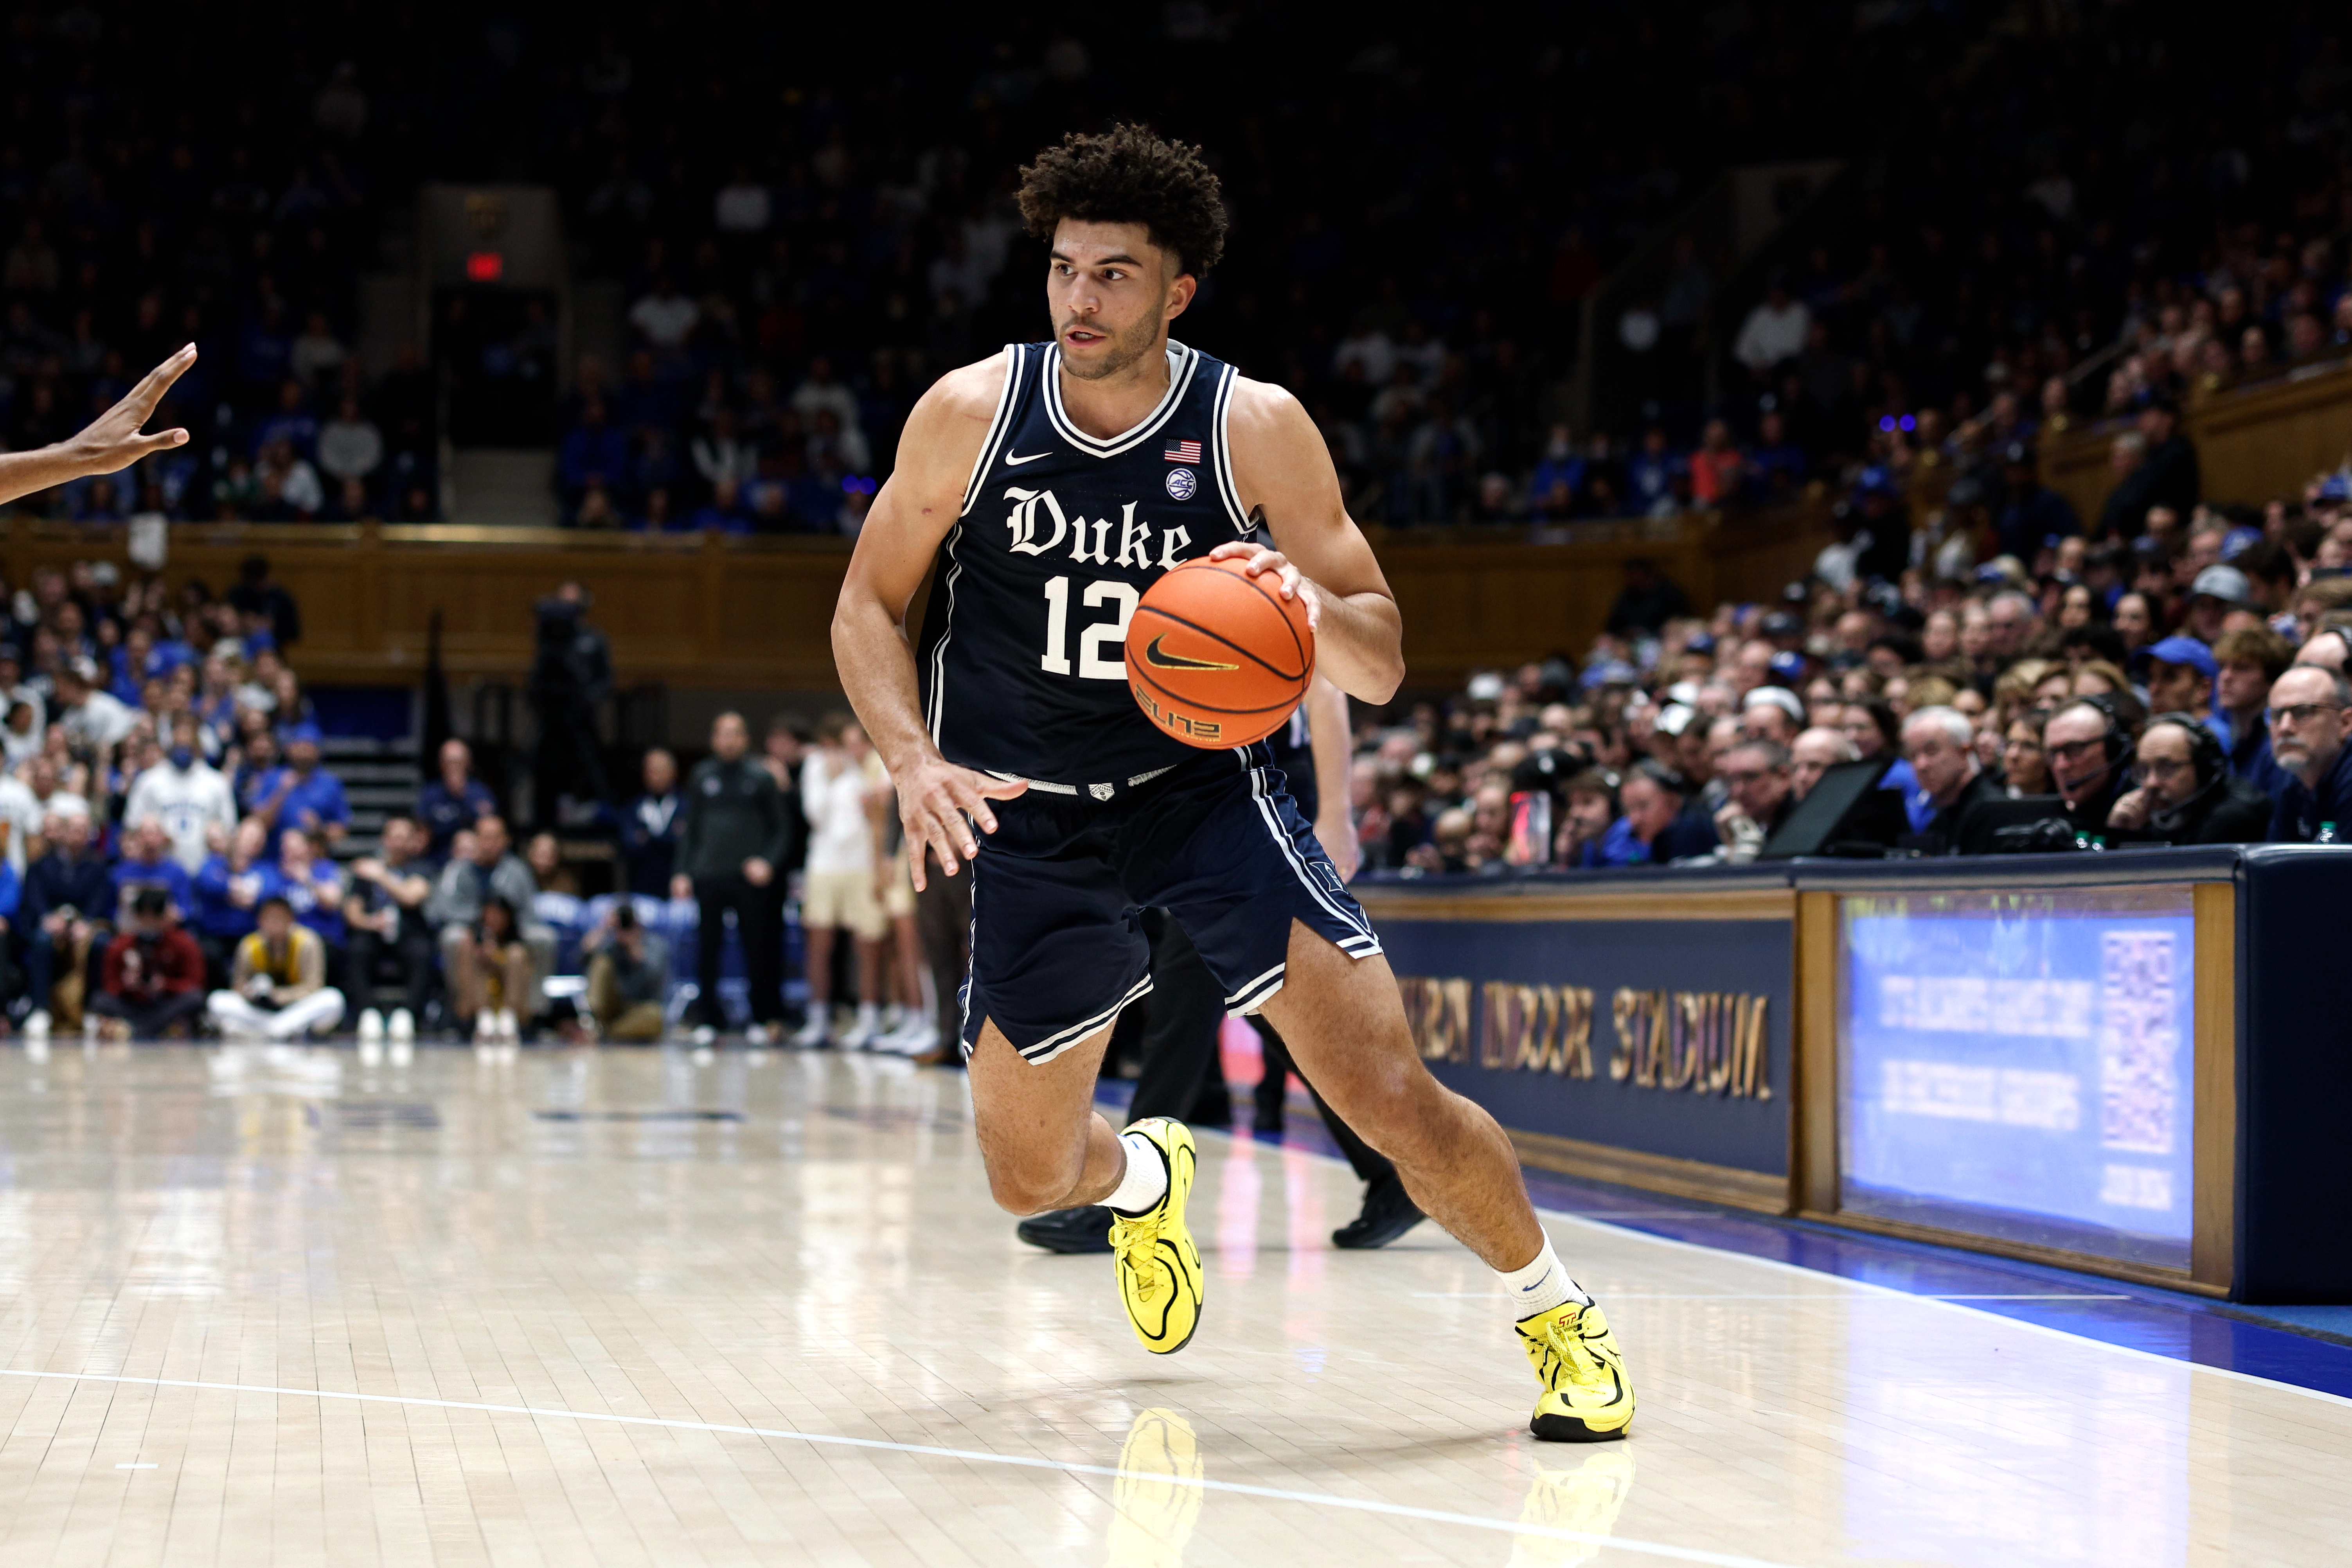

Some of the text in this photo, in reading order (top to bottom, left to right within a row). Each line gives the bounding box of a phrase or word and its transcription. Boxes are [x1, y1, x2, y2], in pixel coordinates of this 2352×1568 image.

[1003, 487, 1192, 571] Duke
[1171, 479, 1194, 487] ACC
[1041, 575, 1140, 680] 12
[1481, 979, 1594, 1080] INDOOR
